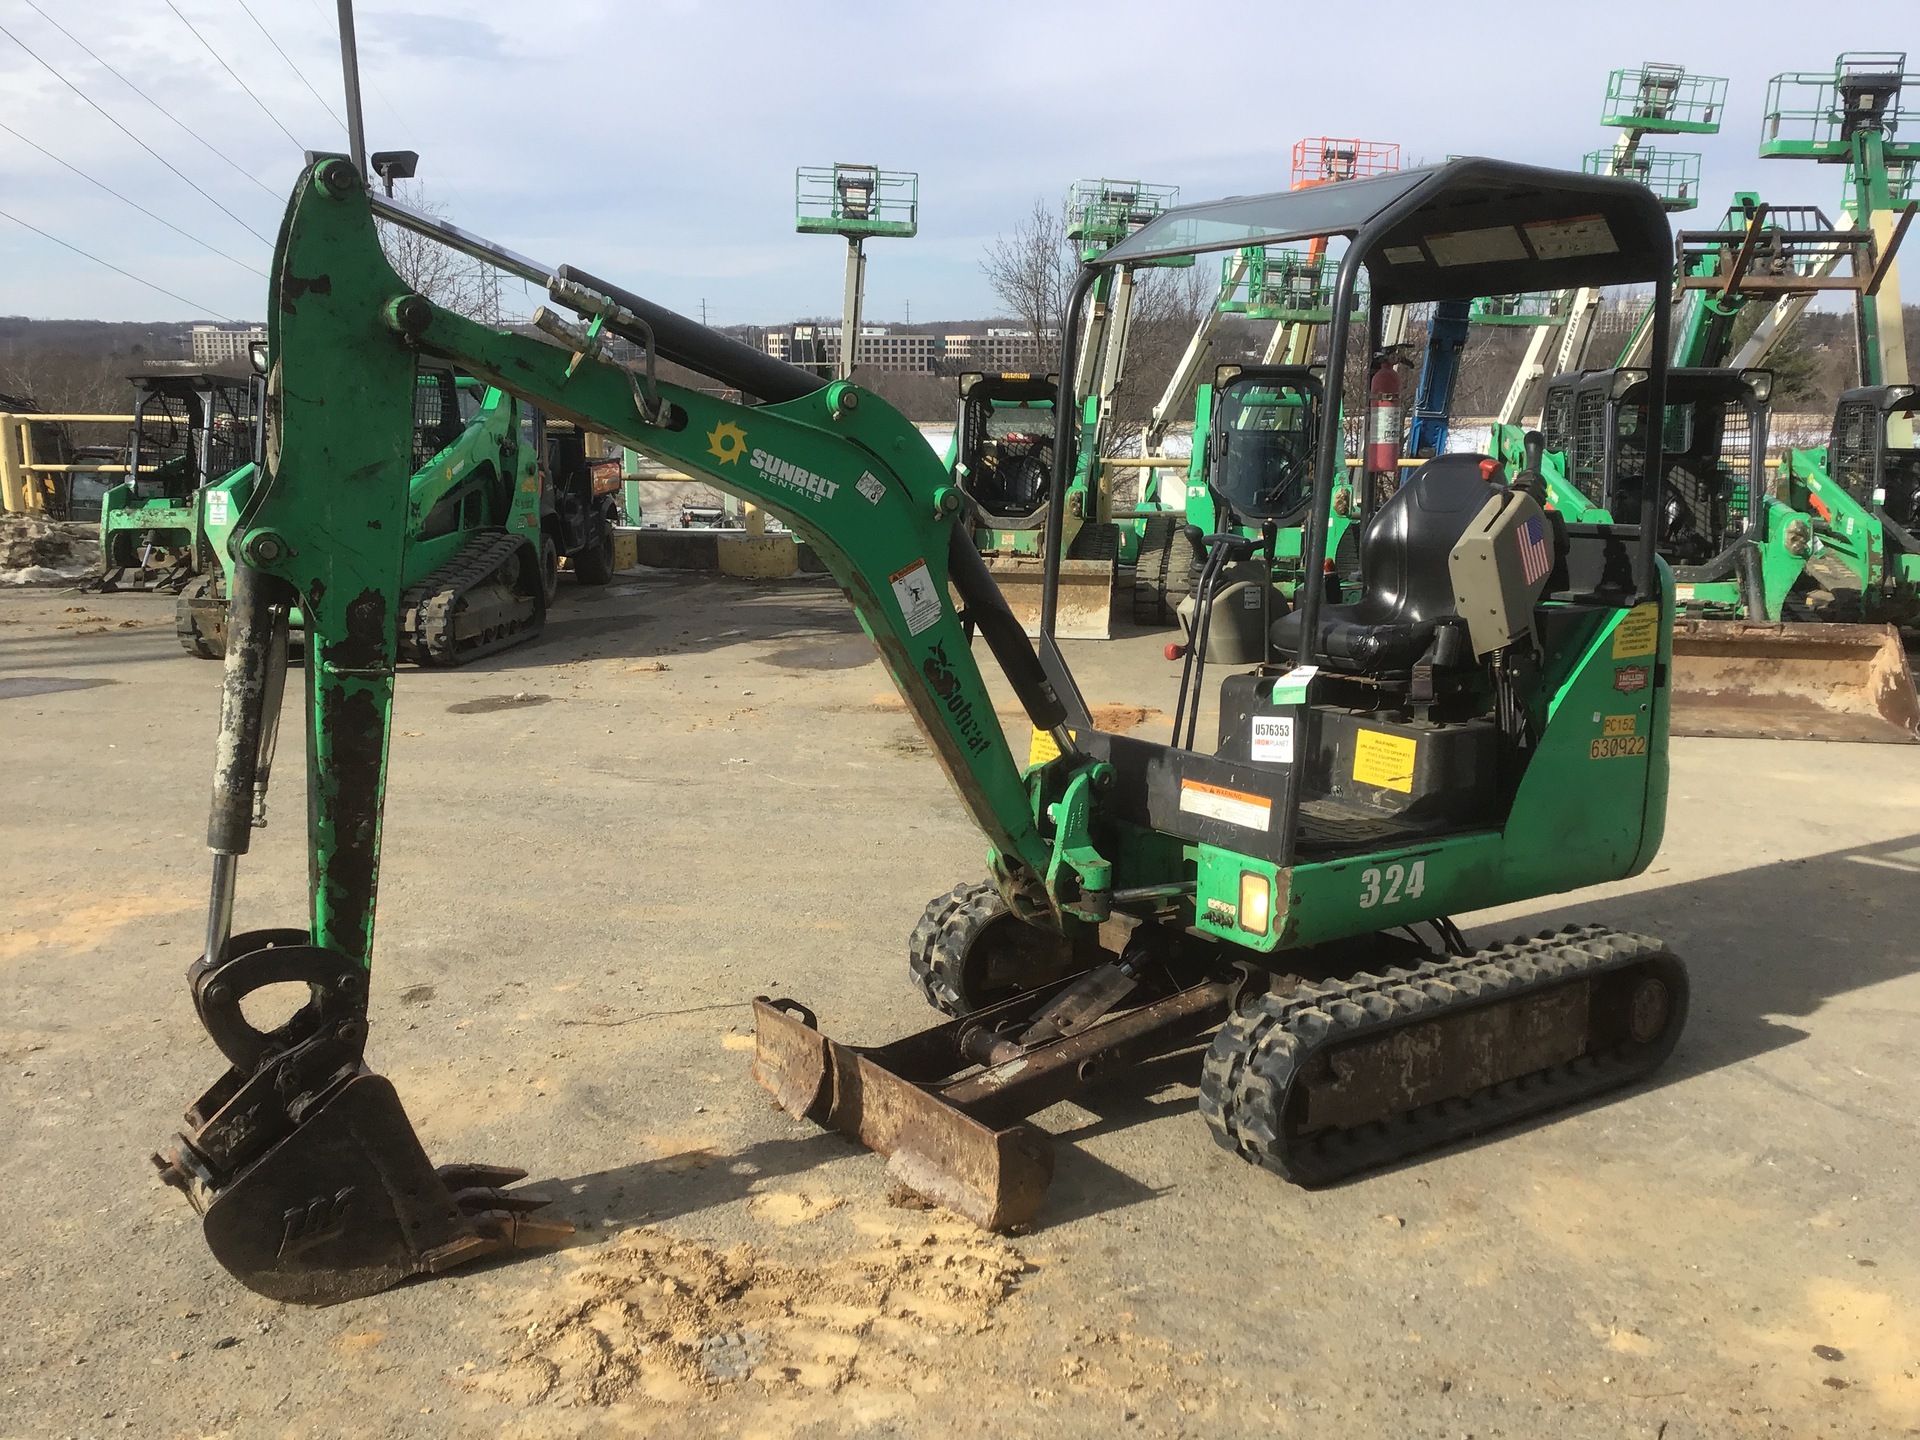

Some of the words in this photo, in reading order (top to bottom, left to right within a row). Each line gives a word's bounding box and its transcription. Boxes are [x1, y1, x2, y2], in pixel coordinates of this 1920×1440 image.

[749, 448, 840, 500] SUNBELT
[758, 470, 822, 503] RENTALS
[1255, 724, 1290, 737] U576353
[1605, 718, 1635, 731] PC152
[1591, 736, 1645, 758] 630922
[1215, 788, 1243, 800] WARNING
[1359, 860, 1425, 909] 324
